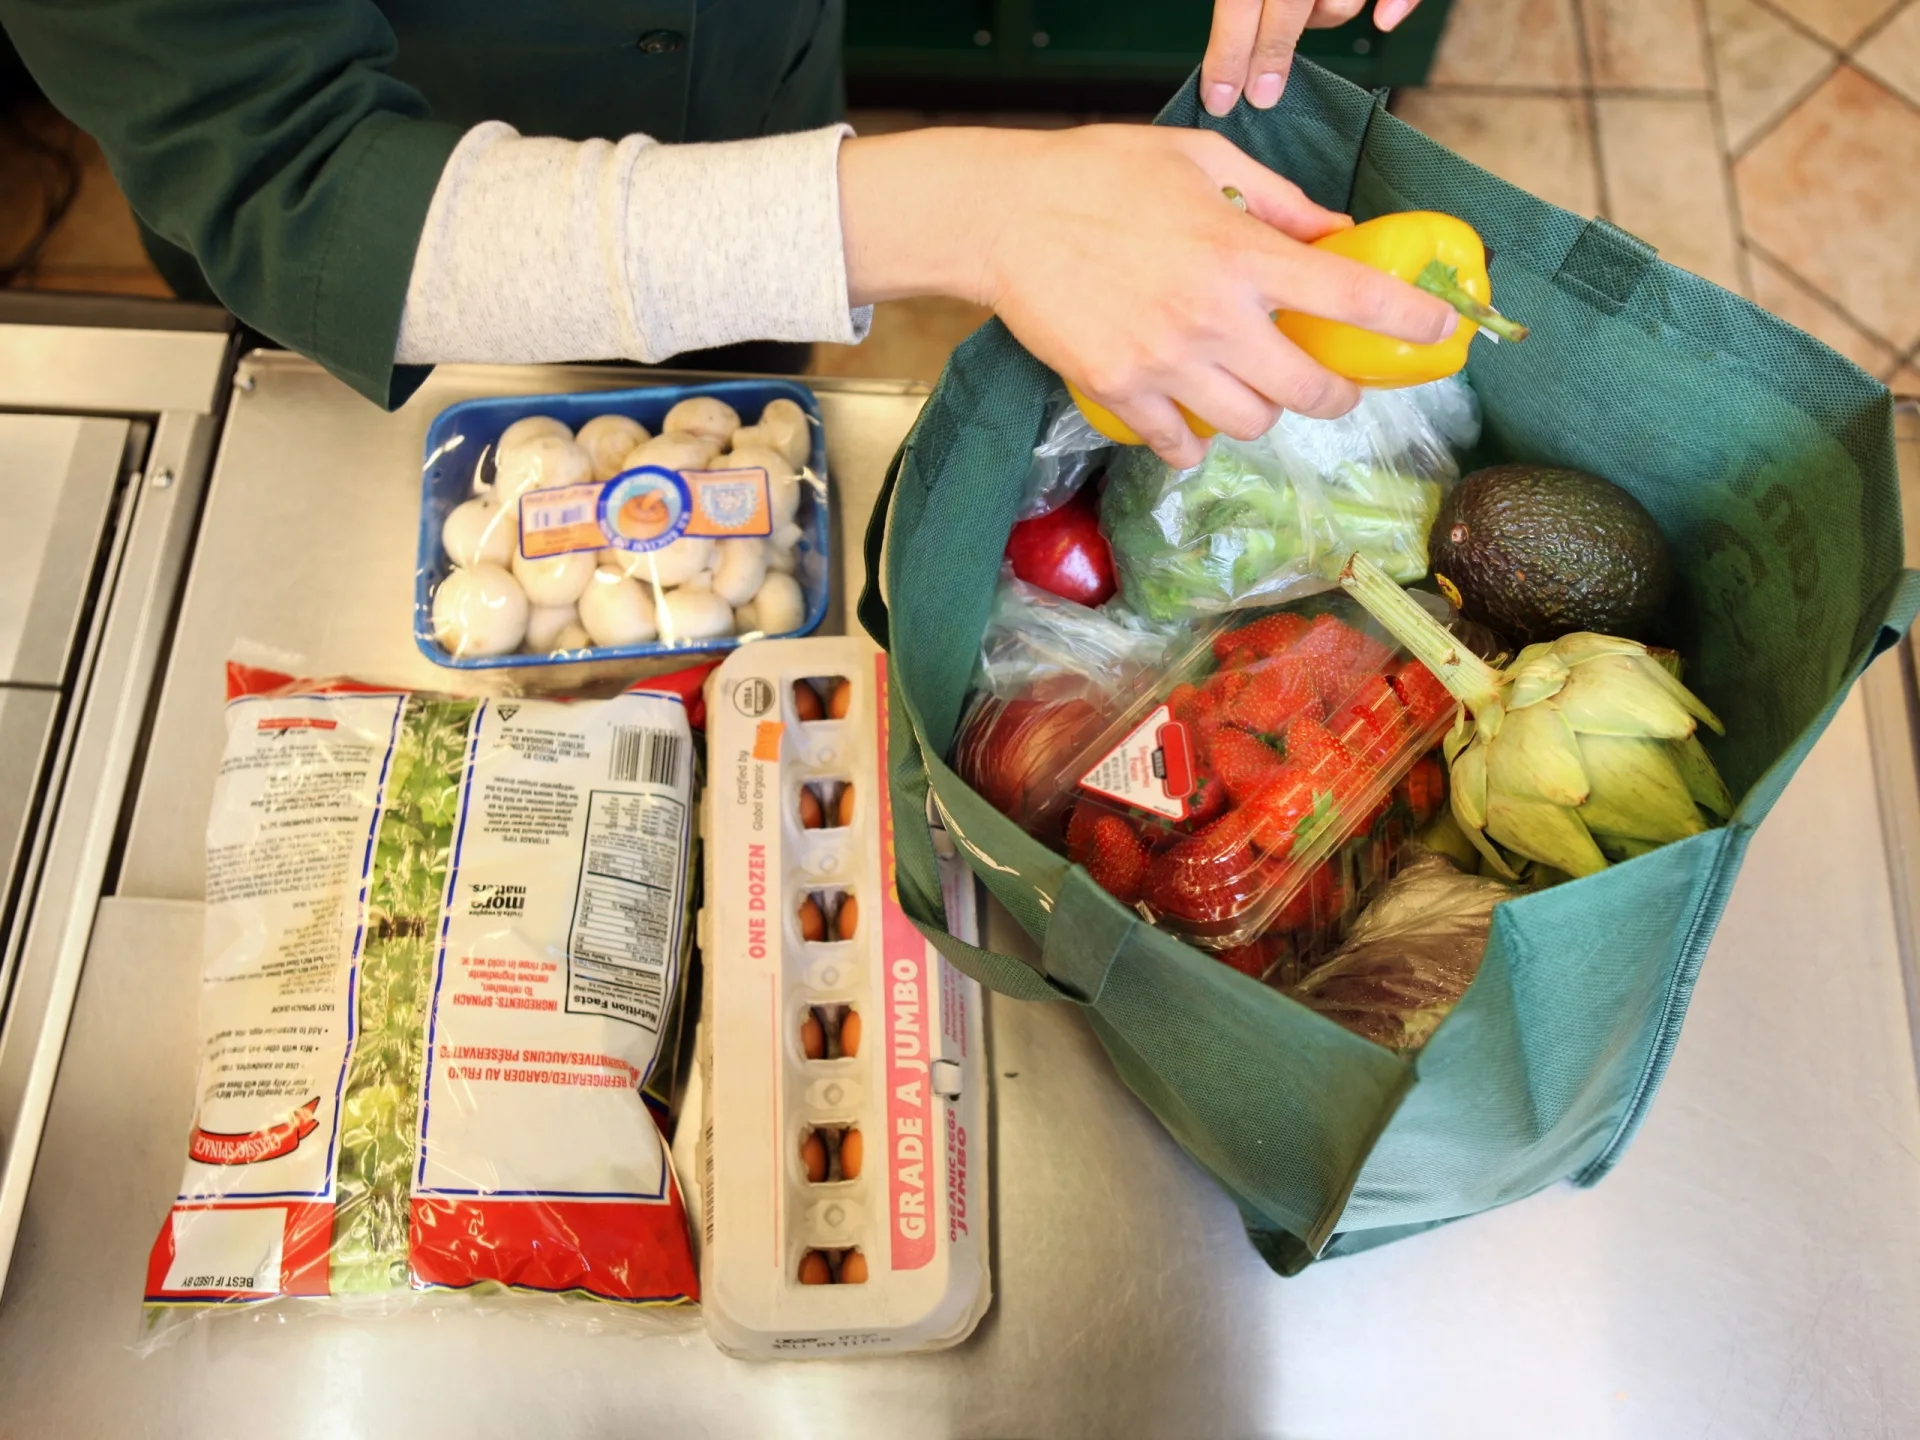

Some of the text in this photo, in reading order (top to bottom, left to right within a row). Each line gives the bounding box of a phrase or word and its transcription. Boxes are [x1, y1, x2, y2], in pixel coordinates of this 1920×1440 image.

[744, 687, 752, 708] USDA
[737, 750, 750, 805] Certified by
[753, 764, 766, 799] Organic
[753, 802, 764, 831] Global
[520, 836, 549, 845] STORAGE
[473, 884, 526, 895] matrs
[748, 843, 766, 959] ONE DOZEN
[461, 957, 486, 966] waer.
[509, 960, 516, 969] in
[542, 963, 557, 972] and
[518, 973, 549, 983] remove
[525, 987, 533, 996] To
[453, 994, 557, 1011] INGREDIENTS: SPINACH
[574, 995, 658, 1023] Nutrition Facts
[308, 1027, 322, 1035] Add
[300, 1045, 313, 1053] Mix
[486, 1068, 500, 1080] AU
[503, 1068, 627, 1088] REFRIGERATED/GARDER
[892, 958, 928, 1240] GRADE A JUMBO
[946, 1108, 957, 1243] ORGANIC EGGS
[956, 1126, 969, 1236] JUMBO
[182, 1276, 254, 1288] BEST IF USED BY
